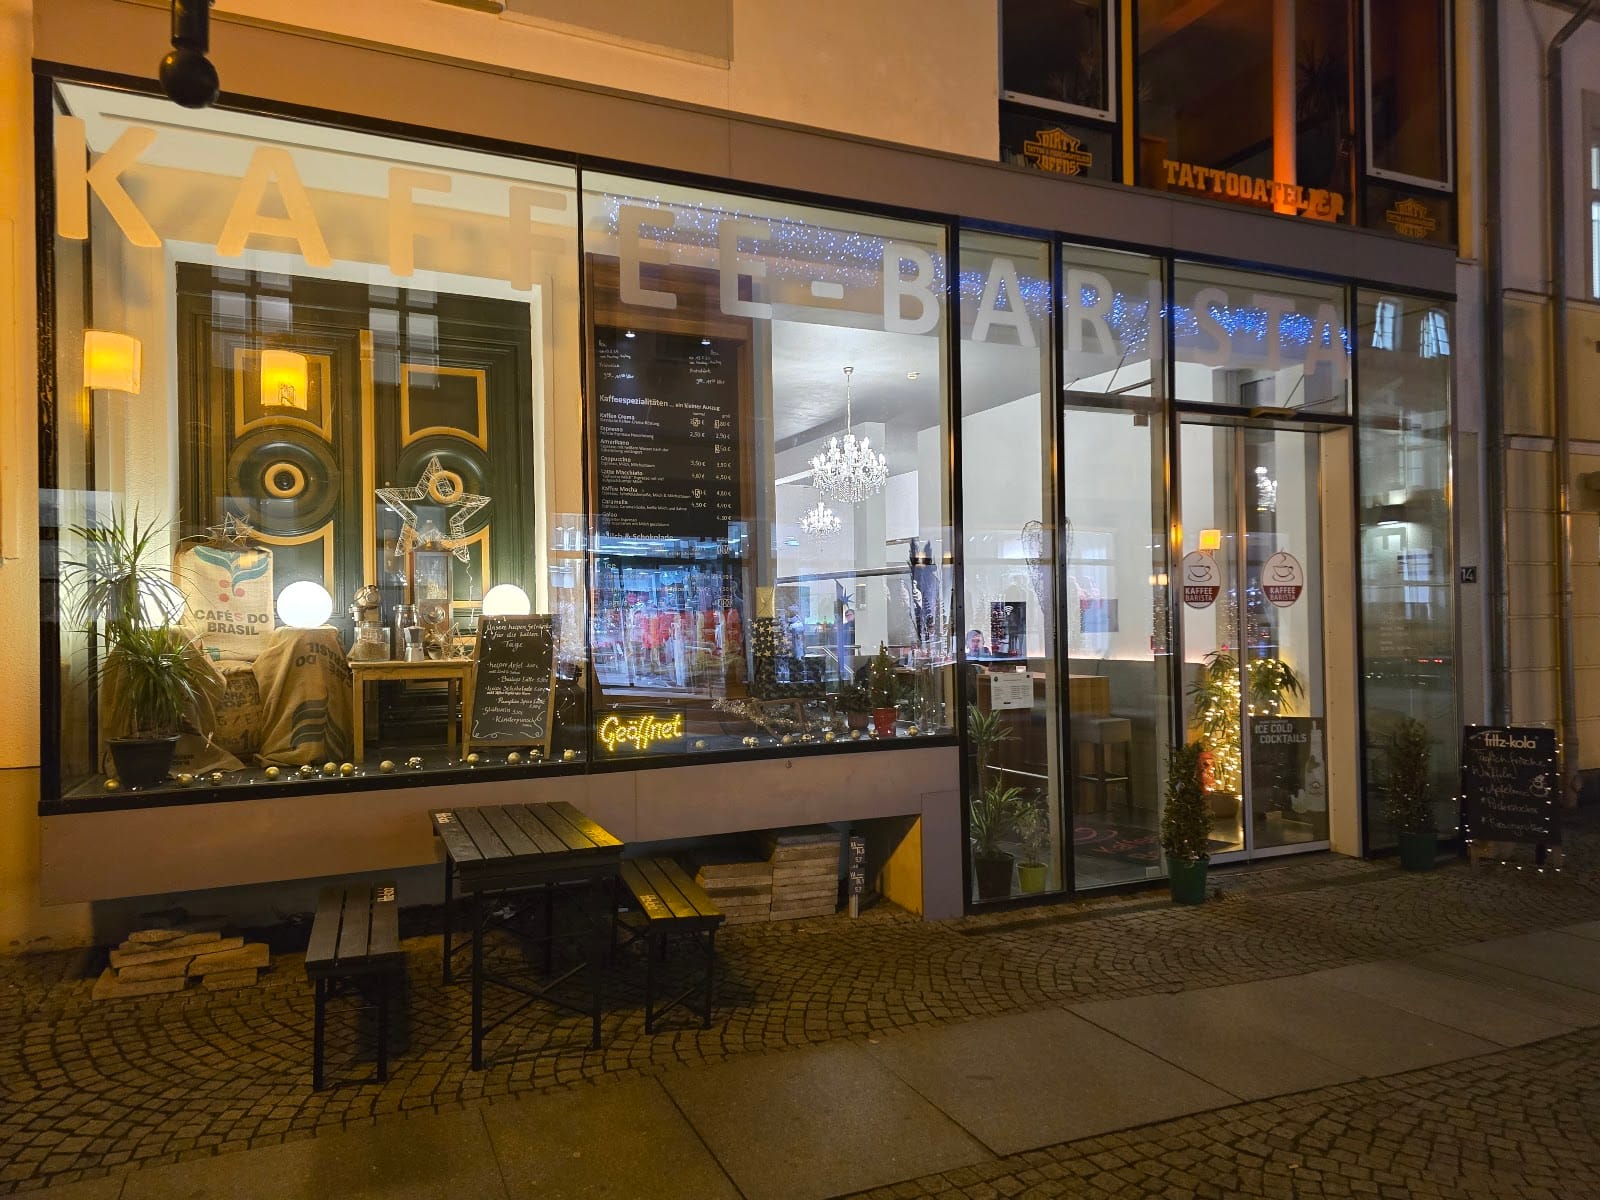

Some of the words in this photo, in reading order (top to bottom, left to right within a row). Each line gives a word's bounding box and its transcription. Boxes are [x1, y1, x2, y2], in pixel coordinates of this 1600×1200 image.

[1042, 132, 1077, 150] DIRTY
[599, 394, 668, 407] Kaffeespezialitäten
[1462, 567, 1474, 580] 14
[195, 609, 243, 622] CAFÉS
[248, 613, 269, 624] DO
[207, 621, 260, 636] BRASIL
[503, 640, 523, 653] Tage
[599, 713, 683, 751] Geöffnet
[1255, 724, 1269, 734] ICE
[1270, 723, 1293, 733] COLD
[1260, 733, 1307, 744] COCKTAILS
[1484, 733, 1537, 749] fritz-kola
